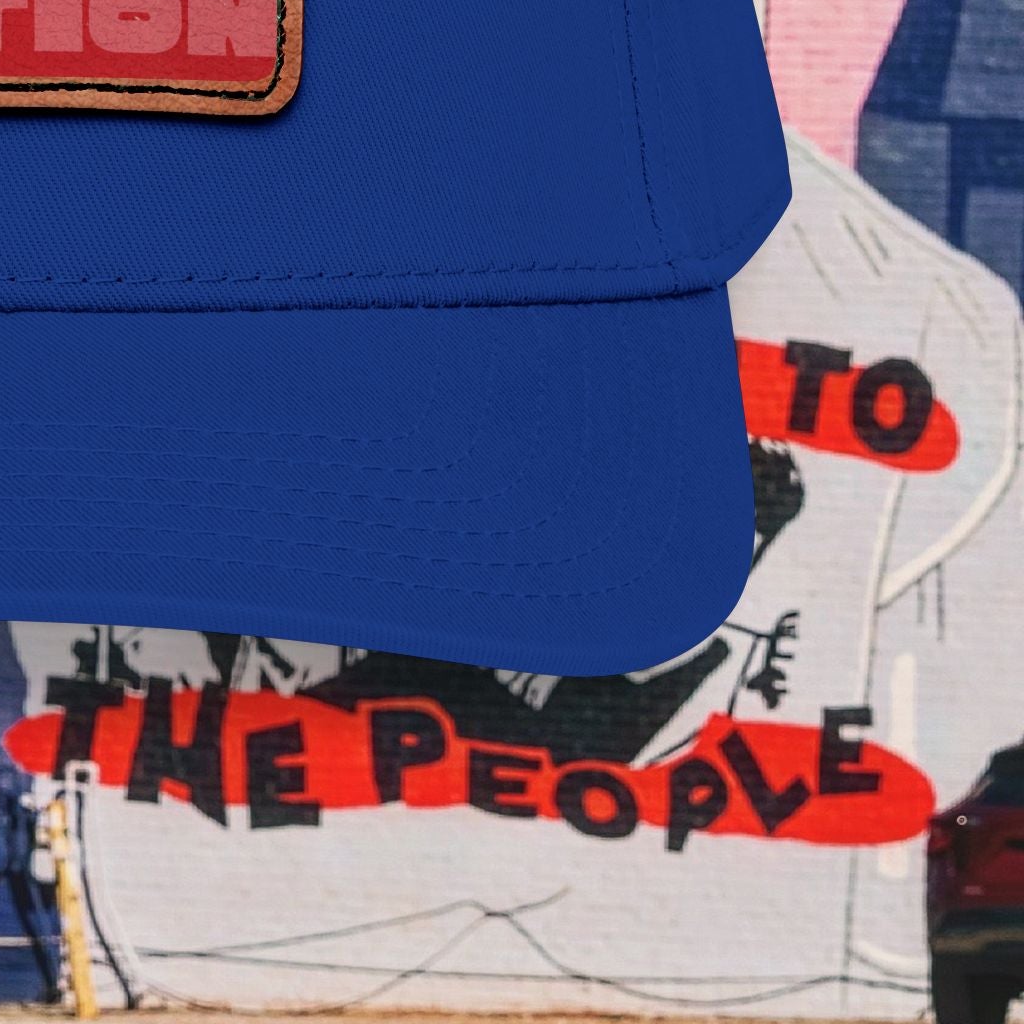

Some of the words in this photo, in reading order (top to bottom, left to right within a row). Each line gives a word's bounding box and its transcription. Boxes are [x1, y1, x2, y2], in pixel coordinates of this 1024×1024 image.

[785, 340, 933, 454] TO
[46, 676, 322, 829] THE
[369, 704, 882, 852] PEOPLE
